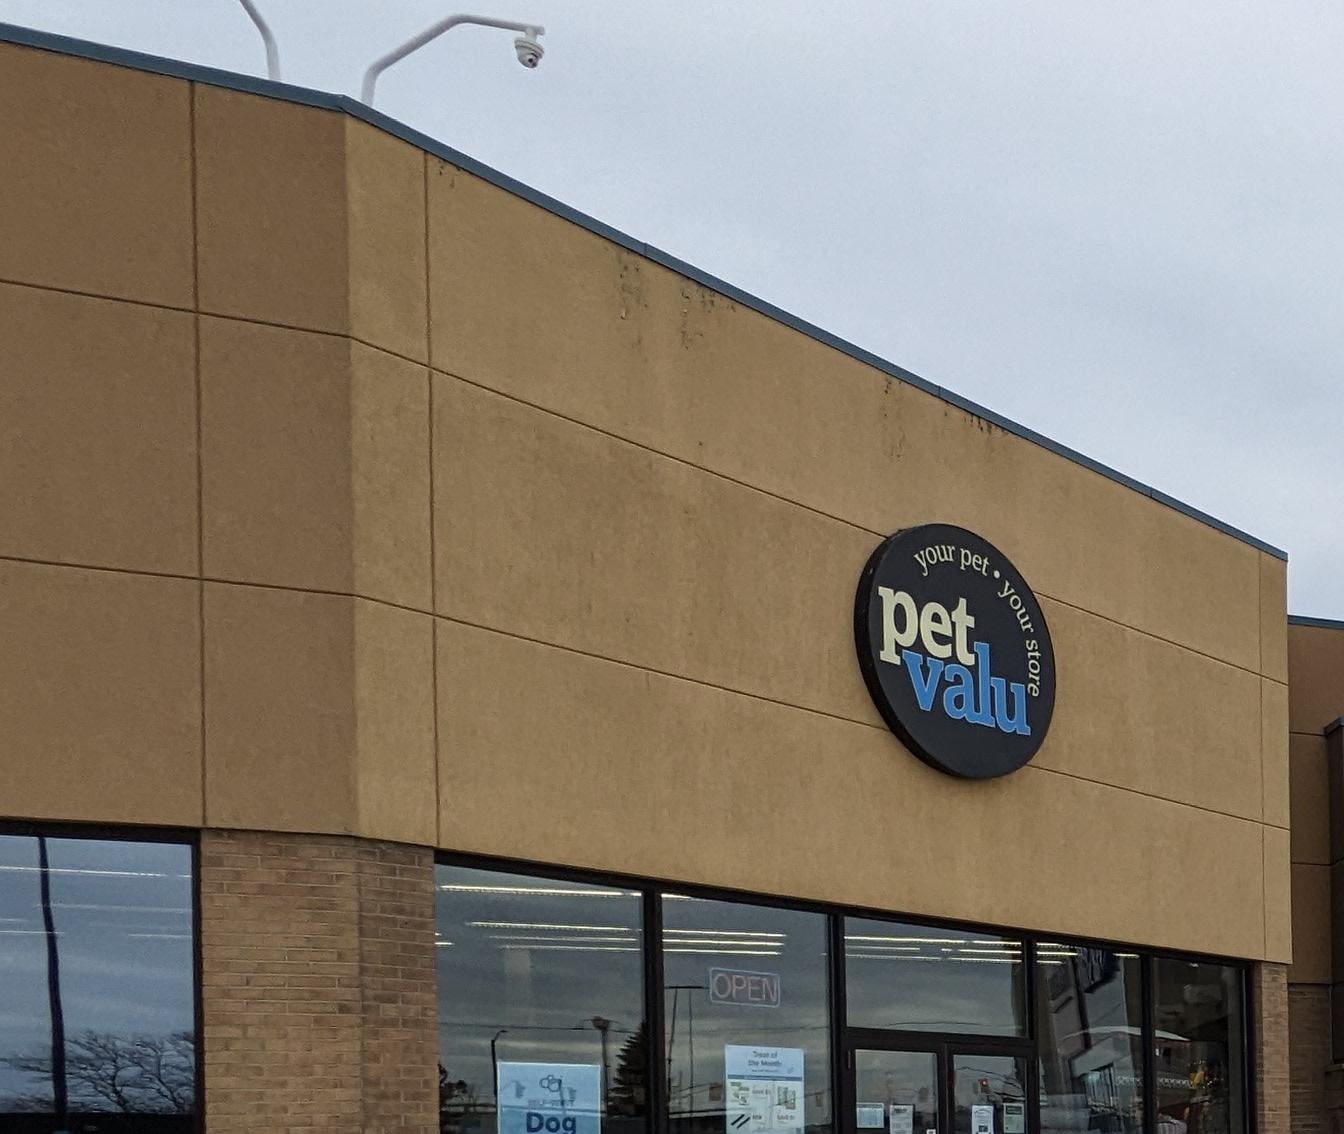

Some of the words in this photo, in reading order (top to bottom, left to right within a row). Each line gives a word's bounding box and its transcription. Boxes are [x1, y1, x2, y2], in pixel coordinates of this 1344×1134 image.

[878, 585, 975, 666] pet
[913, 545, 956, 577] your
[960, 548, 990, 577] pet
[997, 580, 1034, 634] your
[1025, 639, 1041, 697] store
[902, 641, 1031, 736] valu
[714, 973, 777, 1002] OPEN
